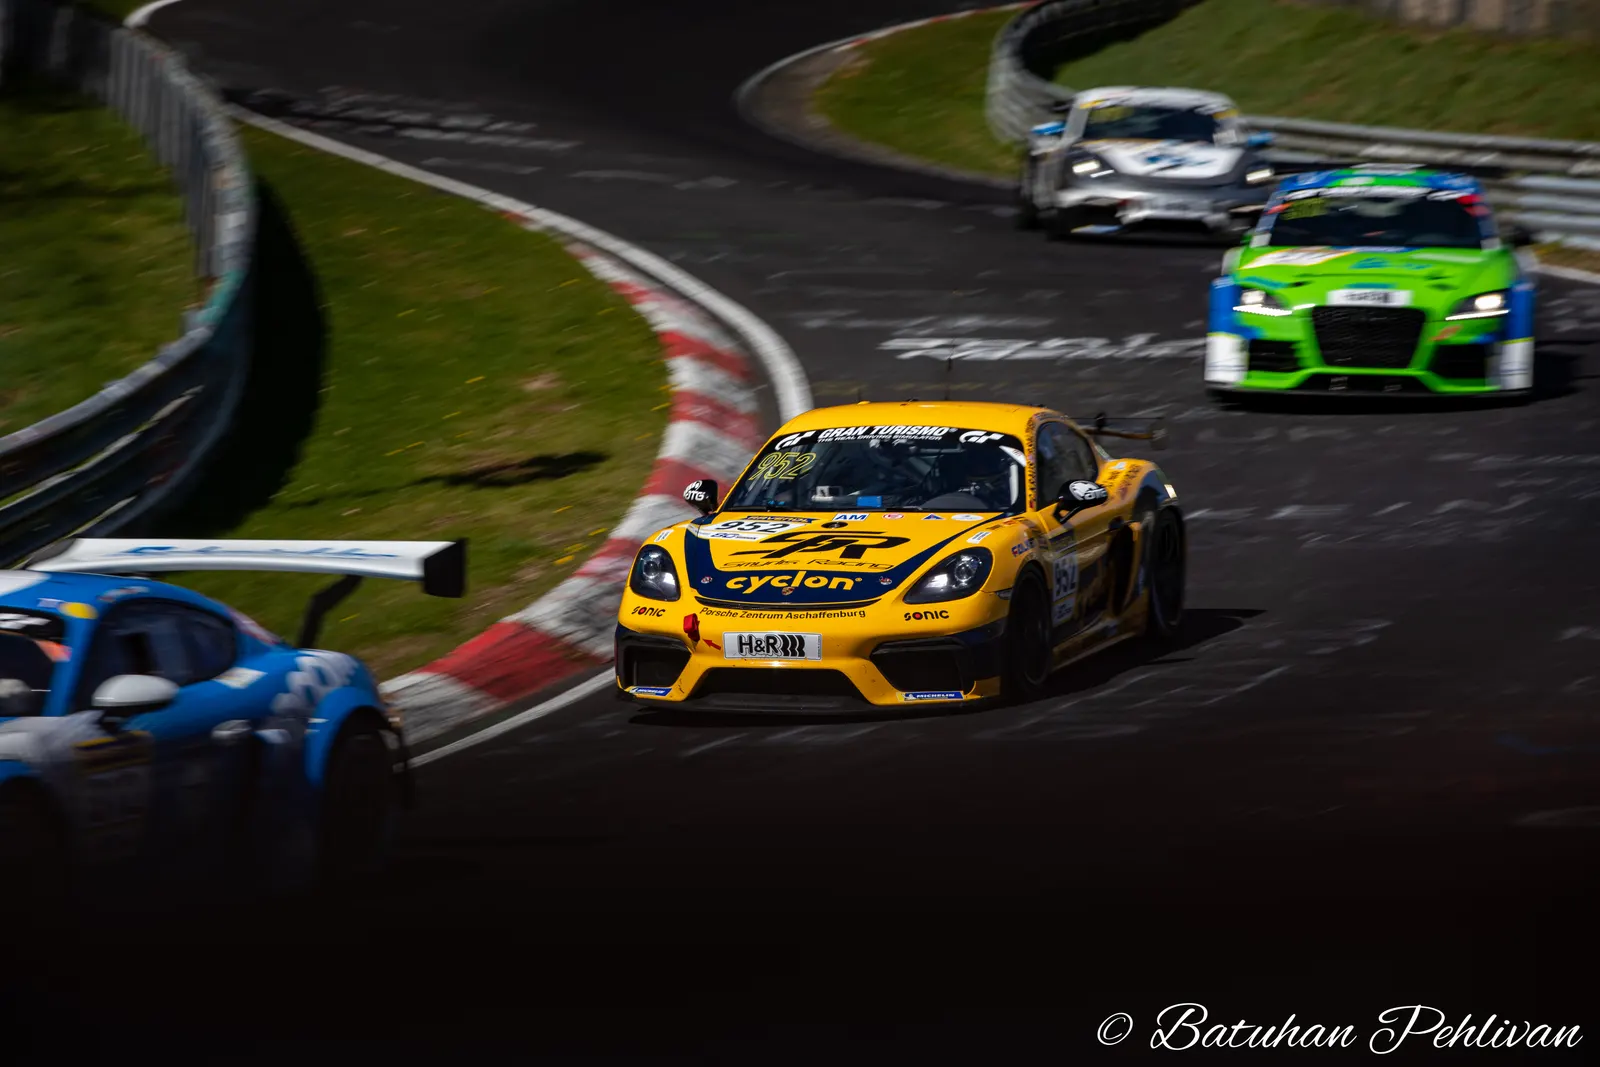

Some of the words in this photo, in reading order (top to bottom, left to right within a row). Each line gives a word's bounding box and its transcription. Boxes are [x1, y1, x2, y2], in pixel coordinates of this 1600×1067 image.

[819, 426, 869, 438] GRAN
[872, 425, 950, 436] TURISMO
[748, 452, 816, 480] 952
[715, 521, 790, 532] 952
[726, 571, 854, 594] cyclon
[700, 607, 738, 617] Porsche
[740, 611, 783, 619] Zentrum
[786, 610, 865, 619] Aschaffenburg
[739, 634, 778, 653] H&R
